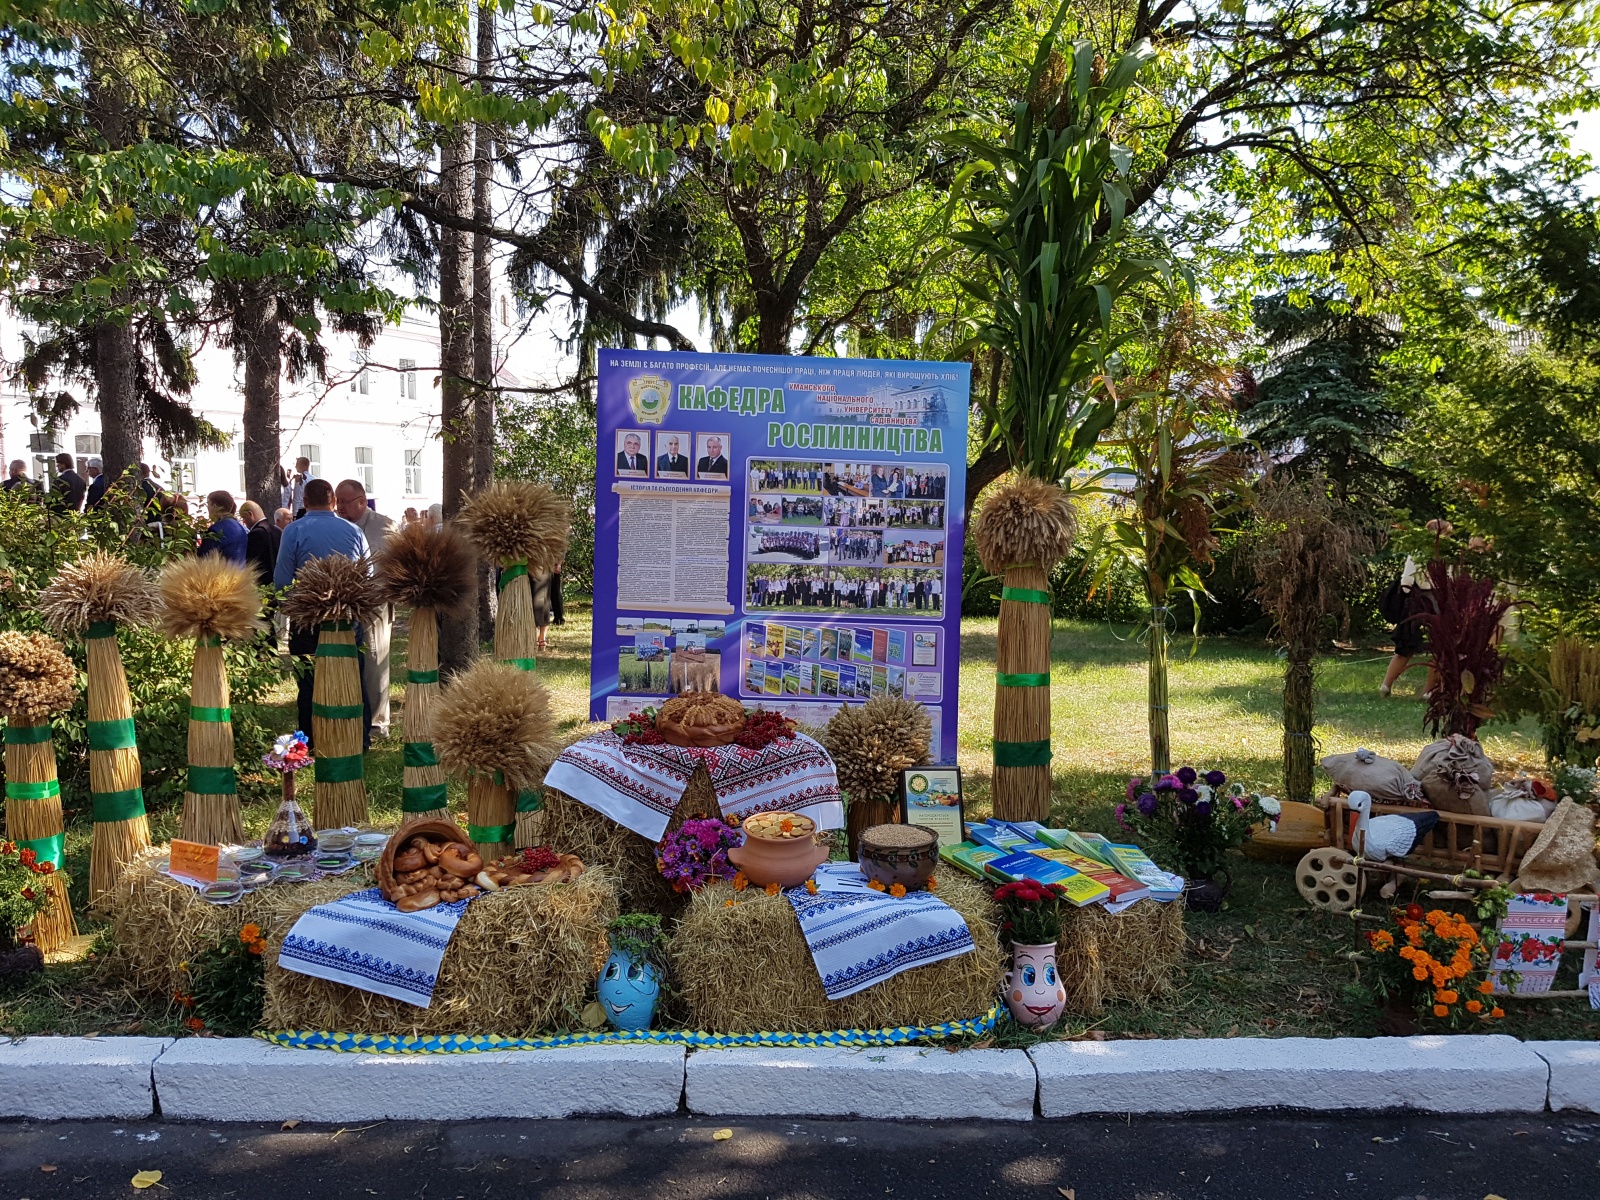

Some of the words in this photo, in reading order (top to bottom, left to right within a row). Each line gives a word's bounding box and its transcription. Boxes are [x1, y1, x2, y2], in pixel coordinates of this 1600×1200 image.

[609, 359, 619, 367] НА
[620, 360, 642, 368] ЗЕМЛІ
[649, 361, 674, 370] БАГАТО
[675, 362, 712, 372] ПРОФЕСІЙ,
[713, 364, 727, 372] АЛЕ
[728, 364, 751, 373] НЕМАЄ
[752, 364, 793, 375] ПОЧЕСНІШОЇ
[795, 367, 816, 376] ПРАЦІ,
[818, 368, 832, 376] НІЖ
[833, 369, 855, 377] ПРАЦЯ
[856, 369, 883, 379] ЛЮДЕЙ,
[884, 371, 896, 379] ЯКІ
[897, 371, 939, 380] ВИРОЩУЮТЬ
[940, 373, 959, 381] ХЛІБ!
[788, 383, 836, 392] УМАНСЬКОГО
[678, 384, 786, 416] КАФЕДРА
[817, 394, 874, 404] НАЦІОНАЛЬНОГО
[843, 405, 894, 414] УНІВЕРСИТЕТУ
[869, 416, 918, 426] САДІВНИЦТВА
[768, 422, 943, 456] РОСЛИННИЦТВА
